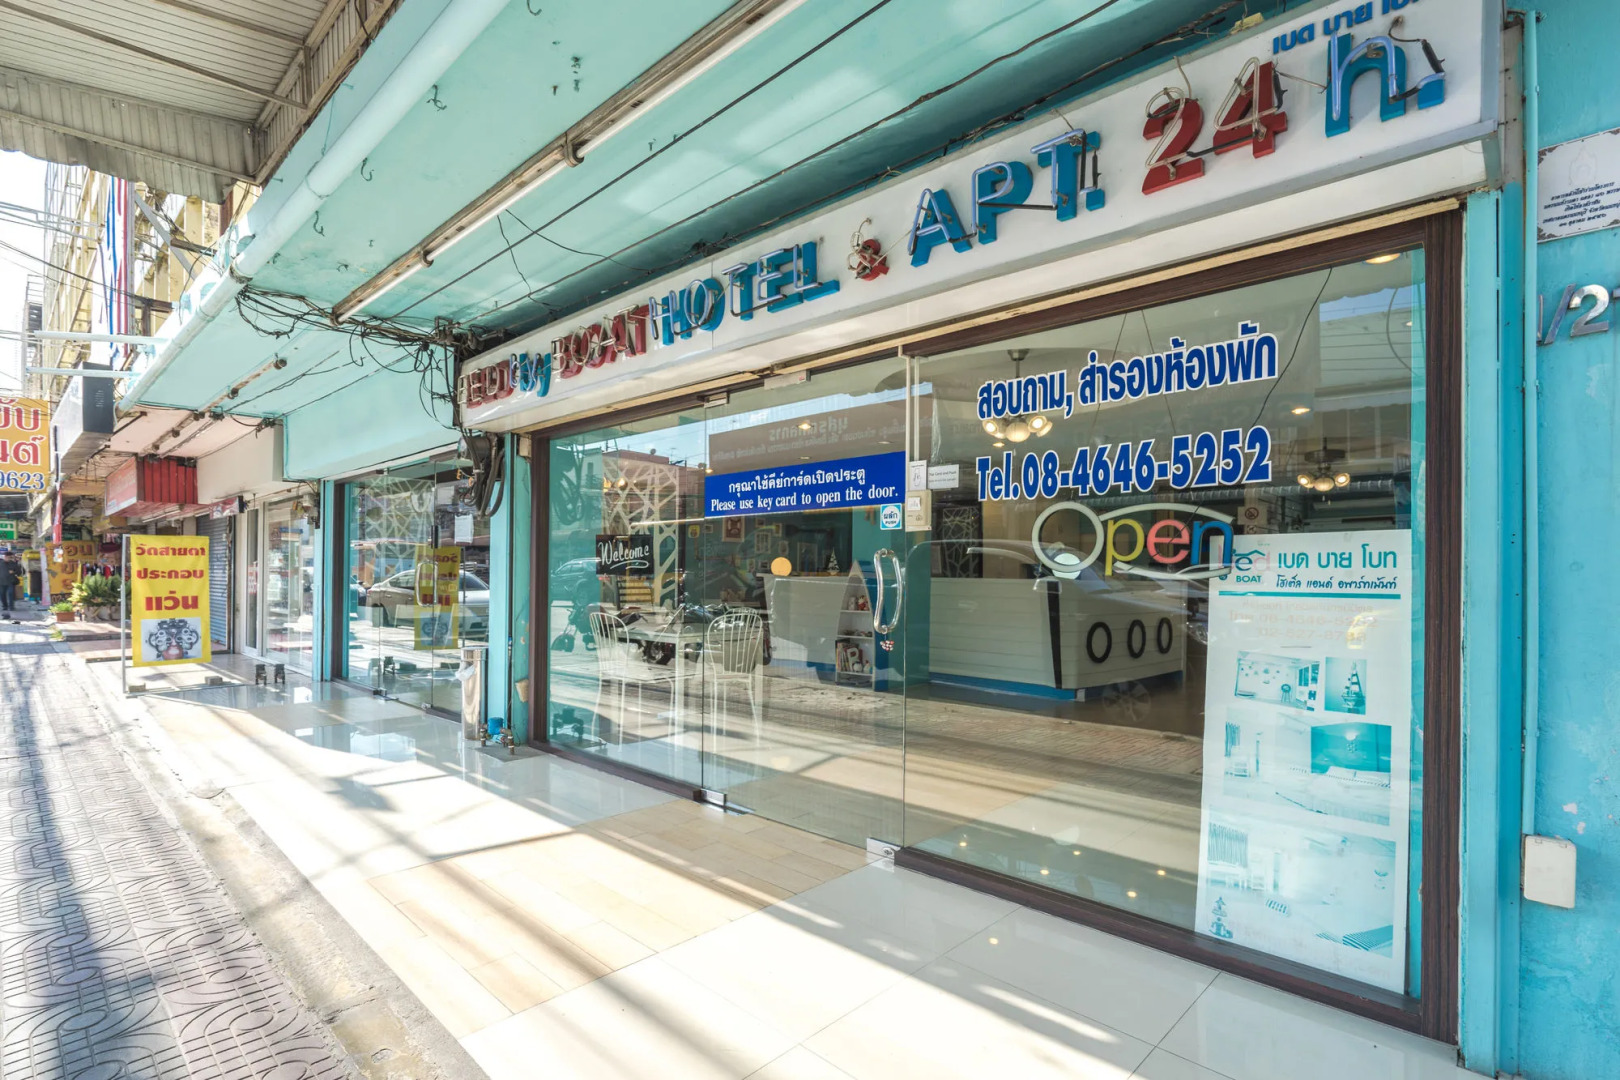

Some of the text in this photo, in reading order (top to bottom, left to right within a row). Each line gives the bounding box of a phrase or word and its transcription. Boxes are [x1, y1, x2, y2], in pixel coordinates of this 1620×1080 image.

[551, 304, 652, 379] BOAT
[649, 241, 840, 346] HOTEL
[848, 231, 889, 282] &
[1142, 57, 1288, 195] 24
[977, 320, 1279, 420] สอบถาม, สำรองห้องพัก
[728, 468, 866, 497] กรุณาใช้คีย์การ์ดเปิดประตู
[711, 484, 899, 512] Please use key card to open the door.
[1031, 501, 1235, 577] Open
[597, 540, 650, 566] Welcome
[1278, 543, 1397, 569] เบด บาย โบท
[136, 567, 204, 580] ประกอบ
[1236, 575, 1262, 583] BOAT
[1307, 575, 1333, 589] แอนด์
[145, 590, 199, 611] แว่น
